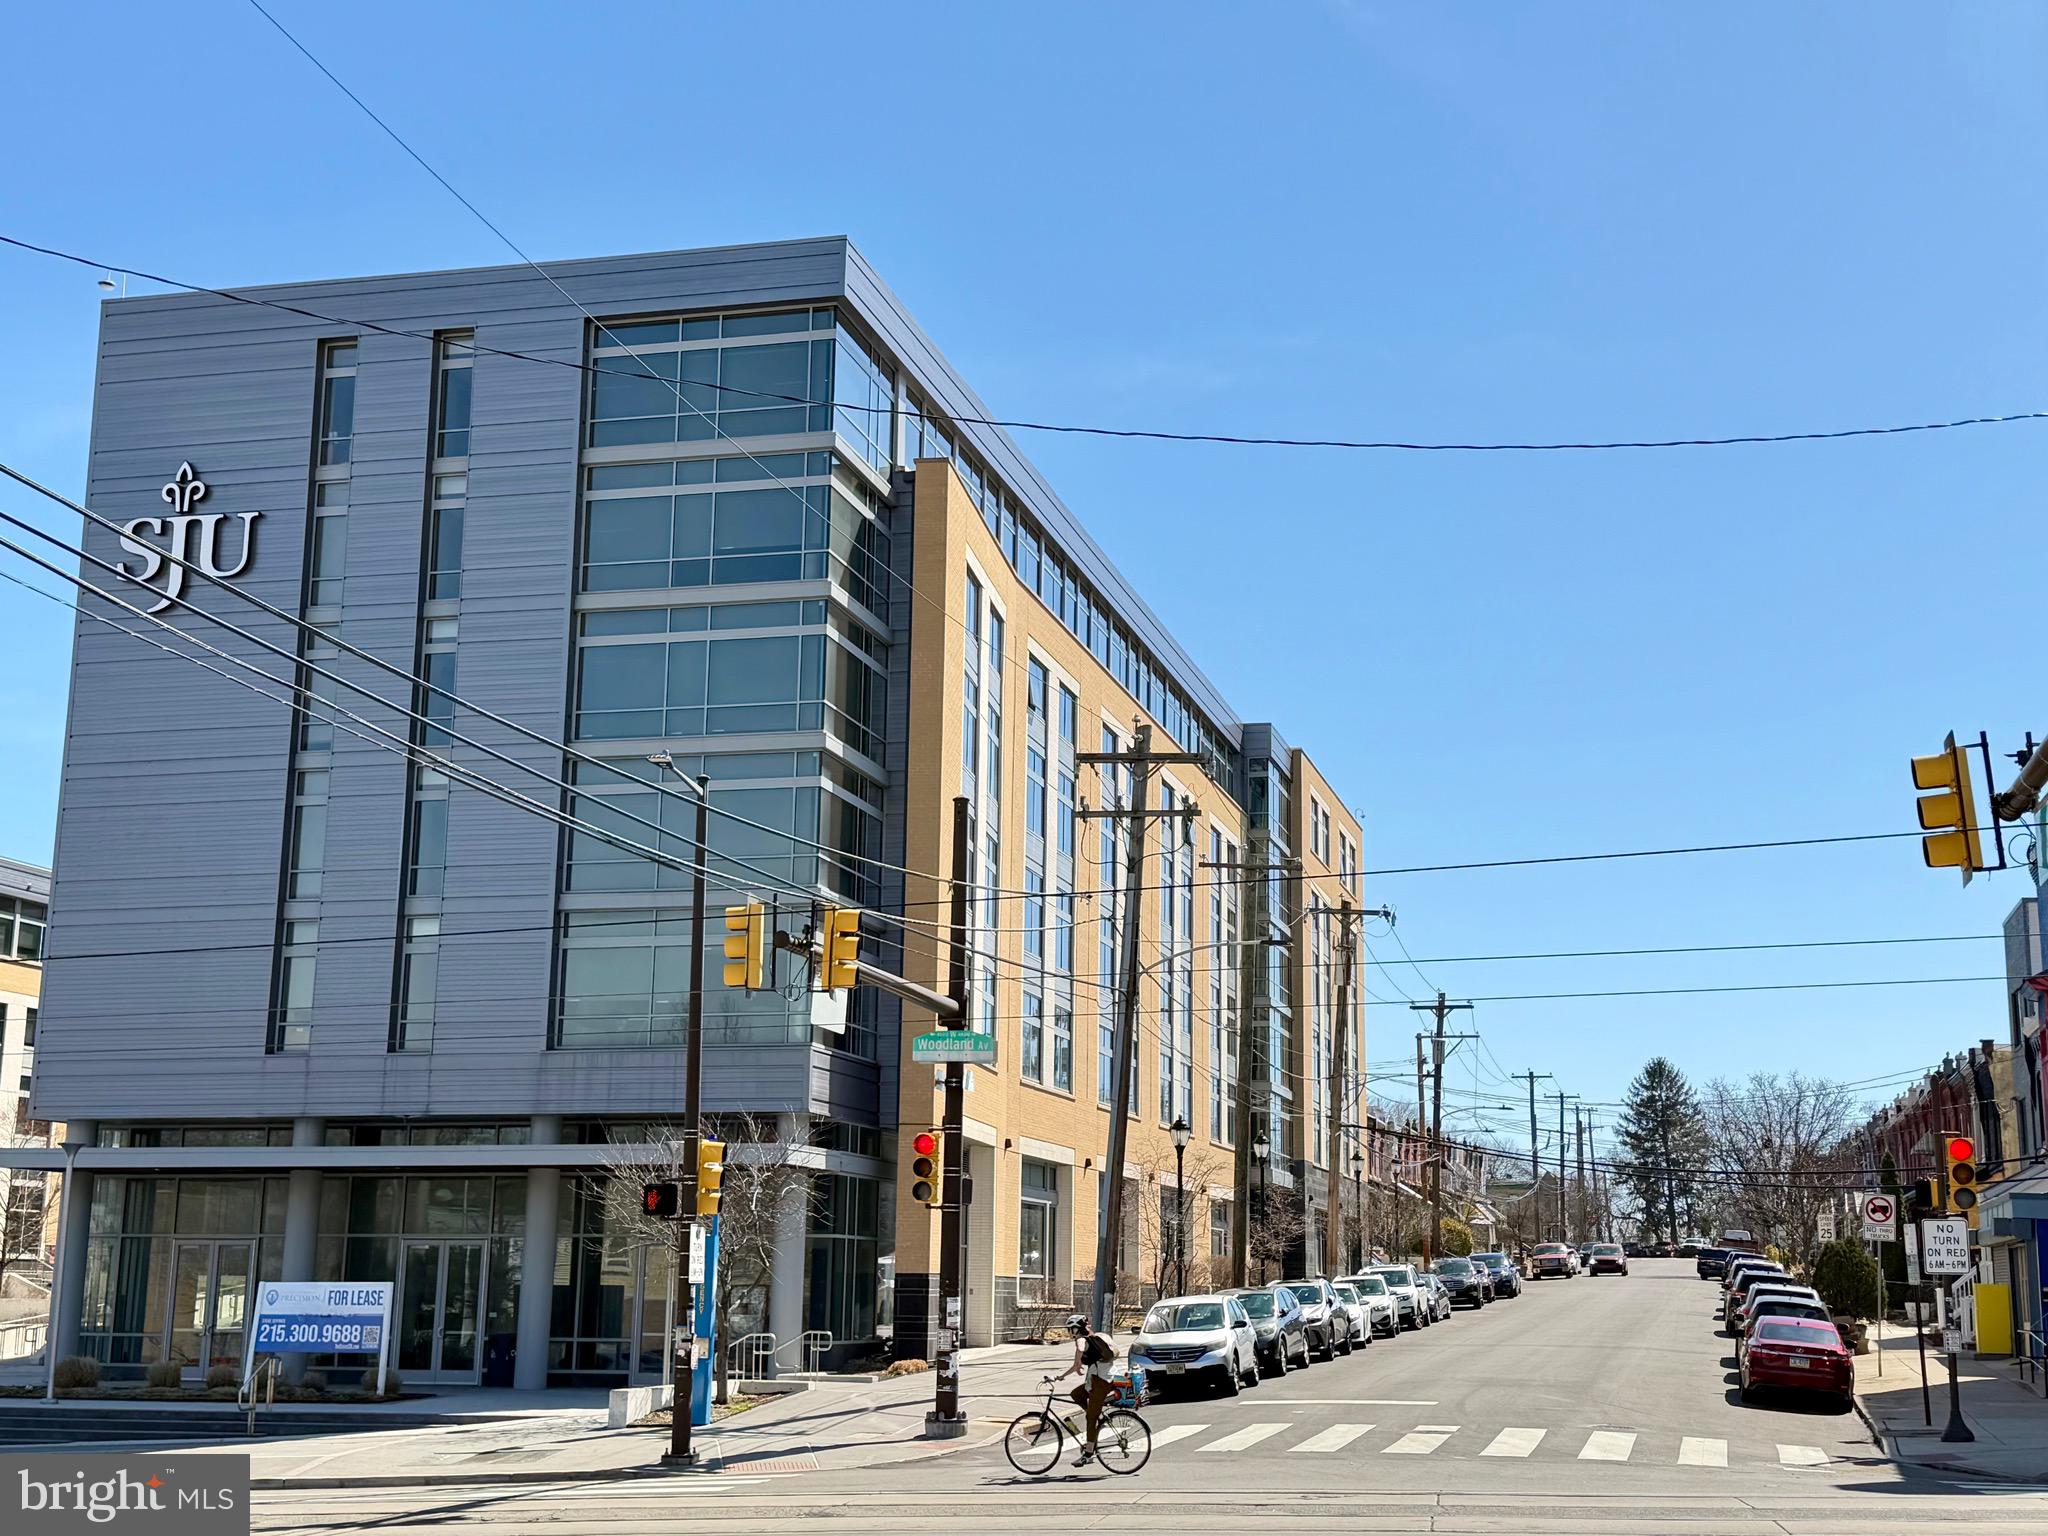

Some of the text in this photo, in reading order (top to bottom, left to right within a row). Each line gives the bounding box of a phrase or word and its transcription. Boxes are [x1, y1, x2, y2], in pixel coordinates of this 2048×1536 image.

[116, 511, 260, 614] SJU
[918, 1038, 989, 1050] Woodland Av
[1820, 1228, 1833, 1239] 25
[1936, 1224, 1954, 1233] NO
[1932, 1236, 1960, 1245] TURN
[1927, 1248, 1967, 1257] ON RED
[328, 1290, 384, 1306] FOR LEASE
[260, 1324, 361, 1343] 215.300.9688
